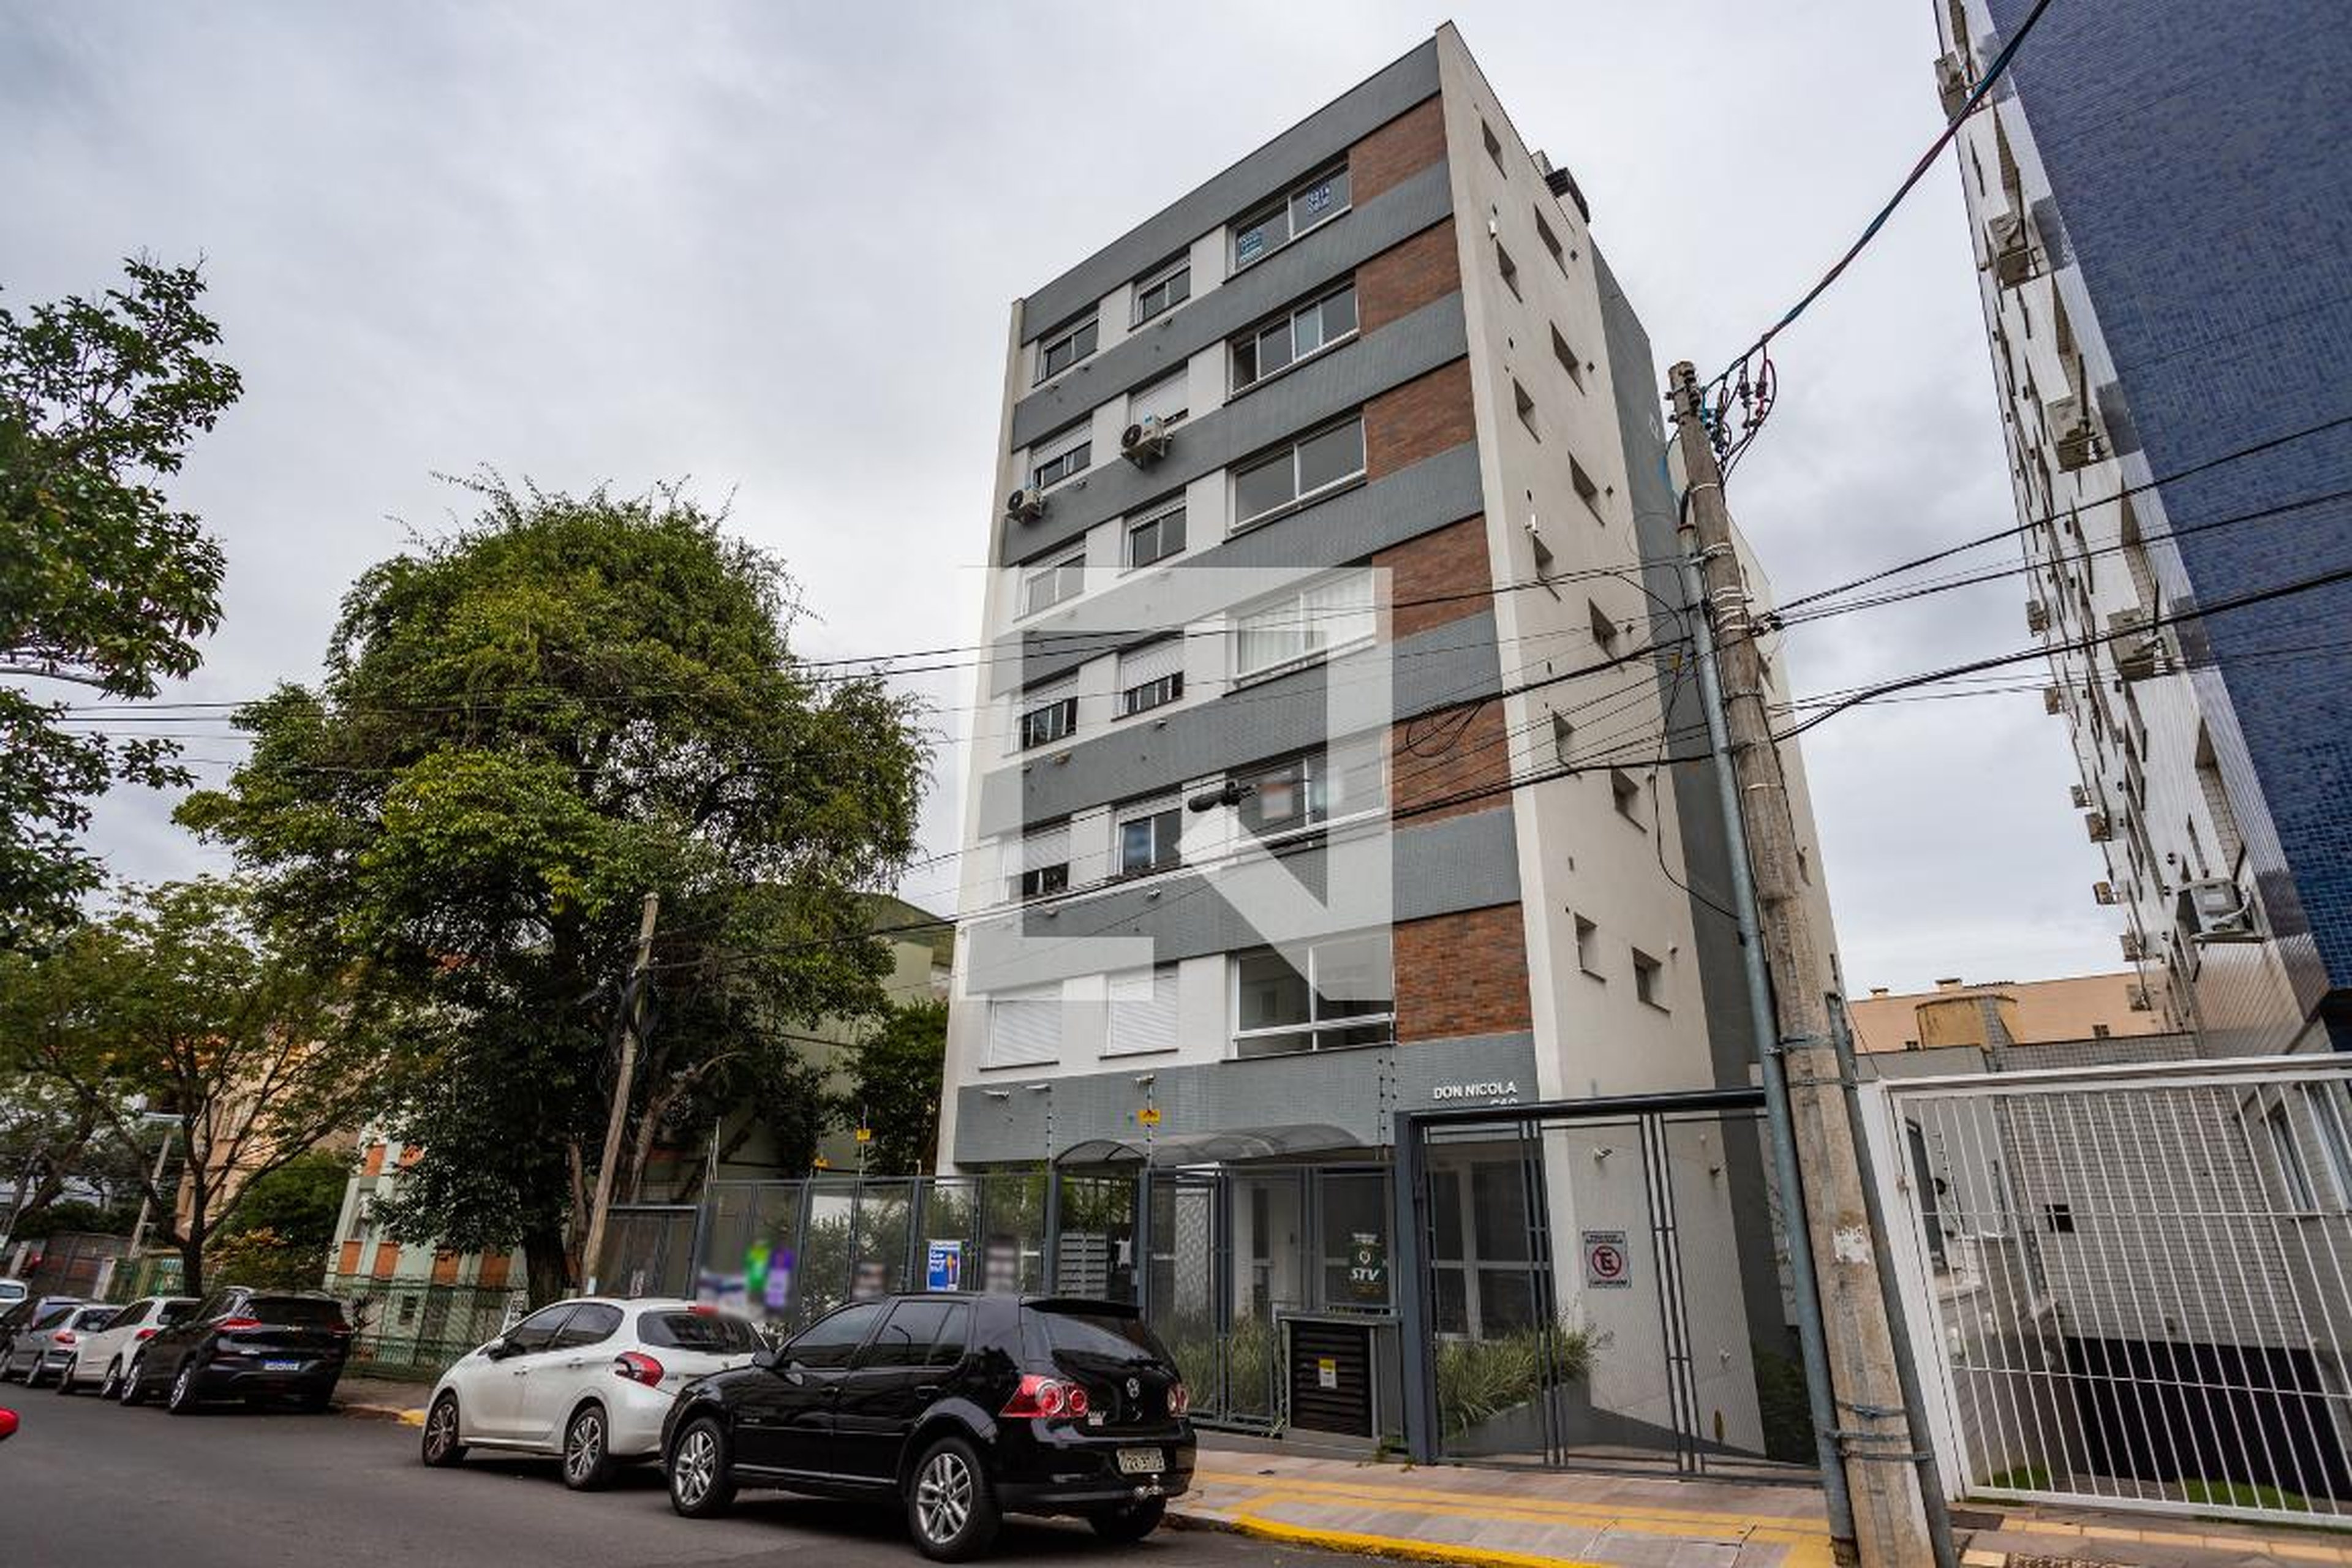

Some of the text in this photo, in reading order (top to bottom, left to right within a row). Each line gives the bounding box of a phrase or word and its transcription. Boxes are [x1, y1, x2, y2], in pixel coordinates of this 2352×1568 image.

[1434, 1081, 1518, 1099] DON NICOLA
[1351, 1267, 1381, 1281] STV
